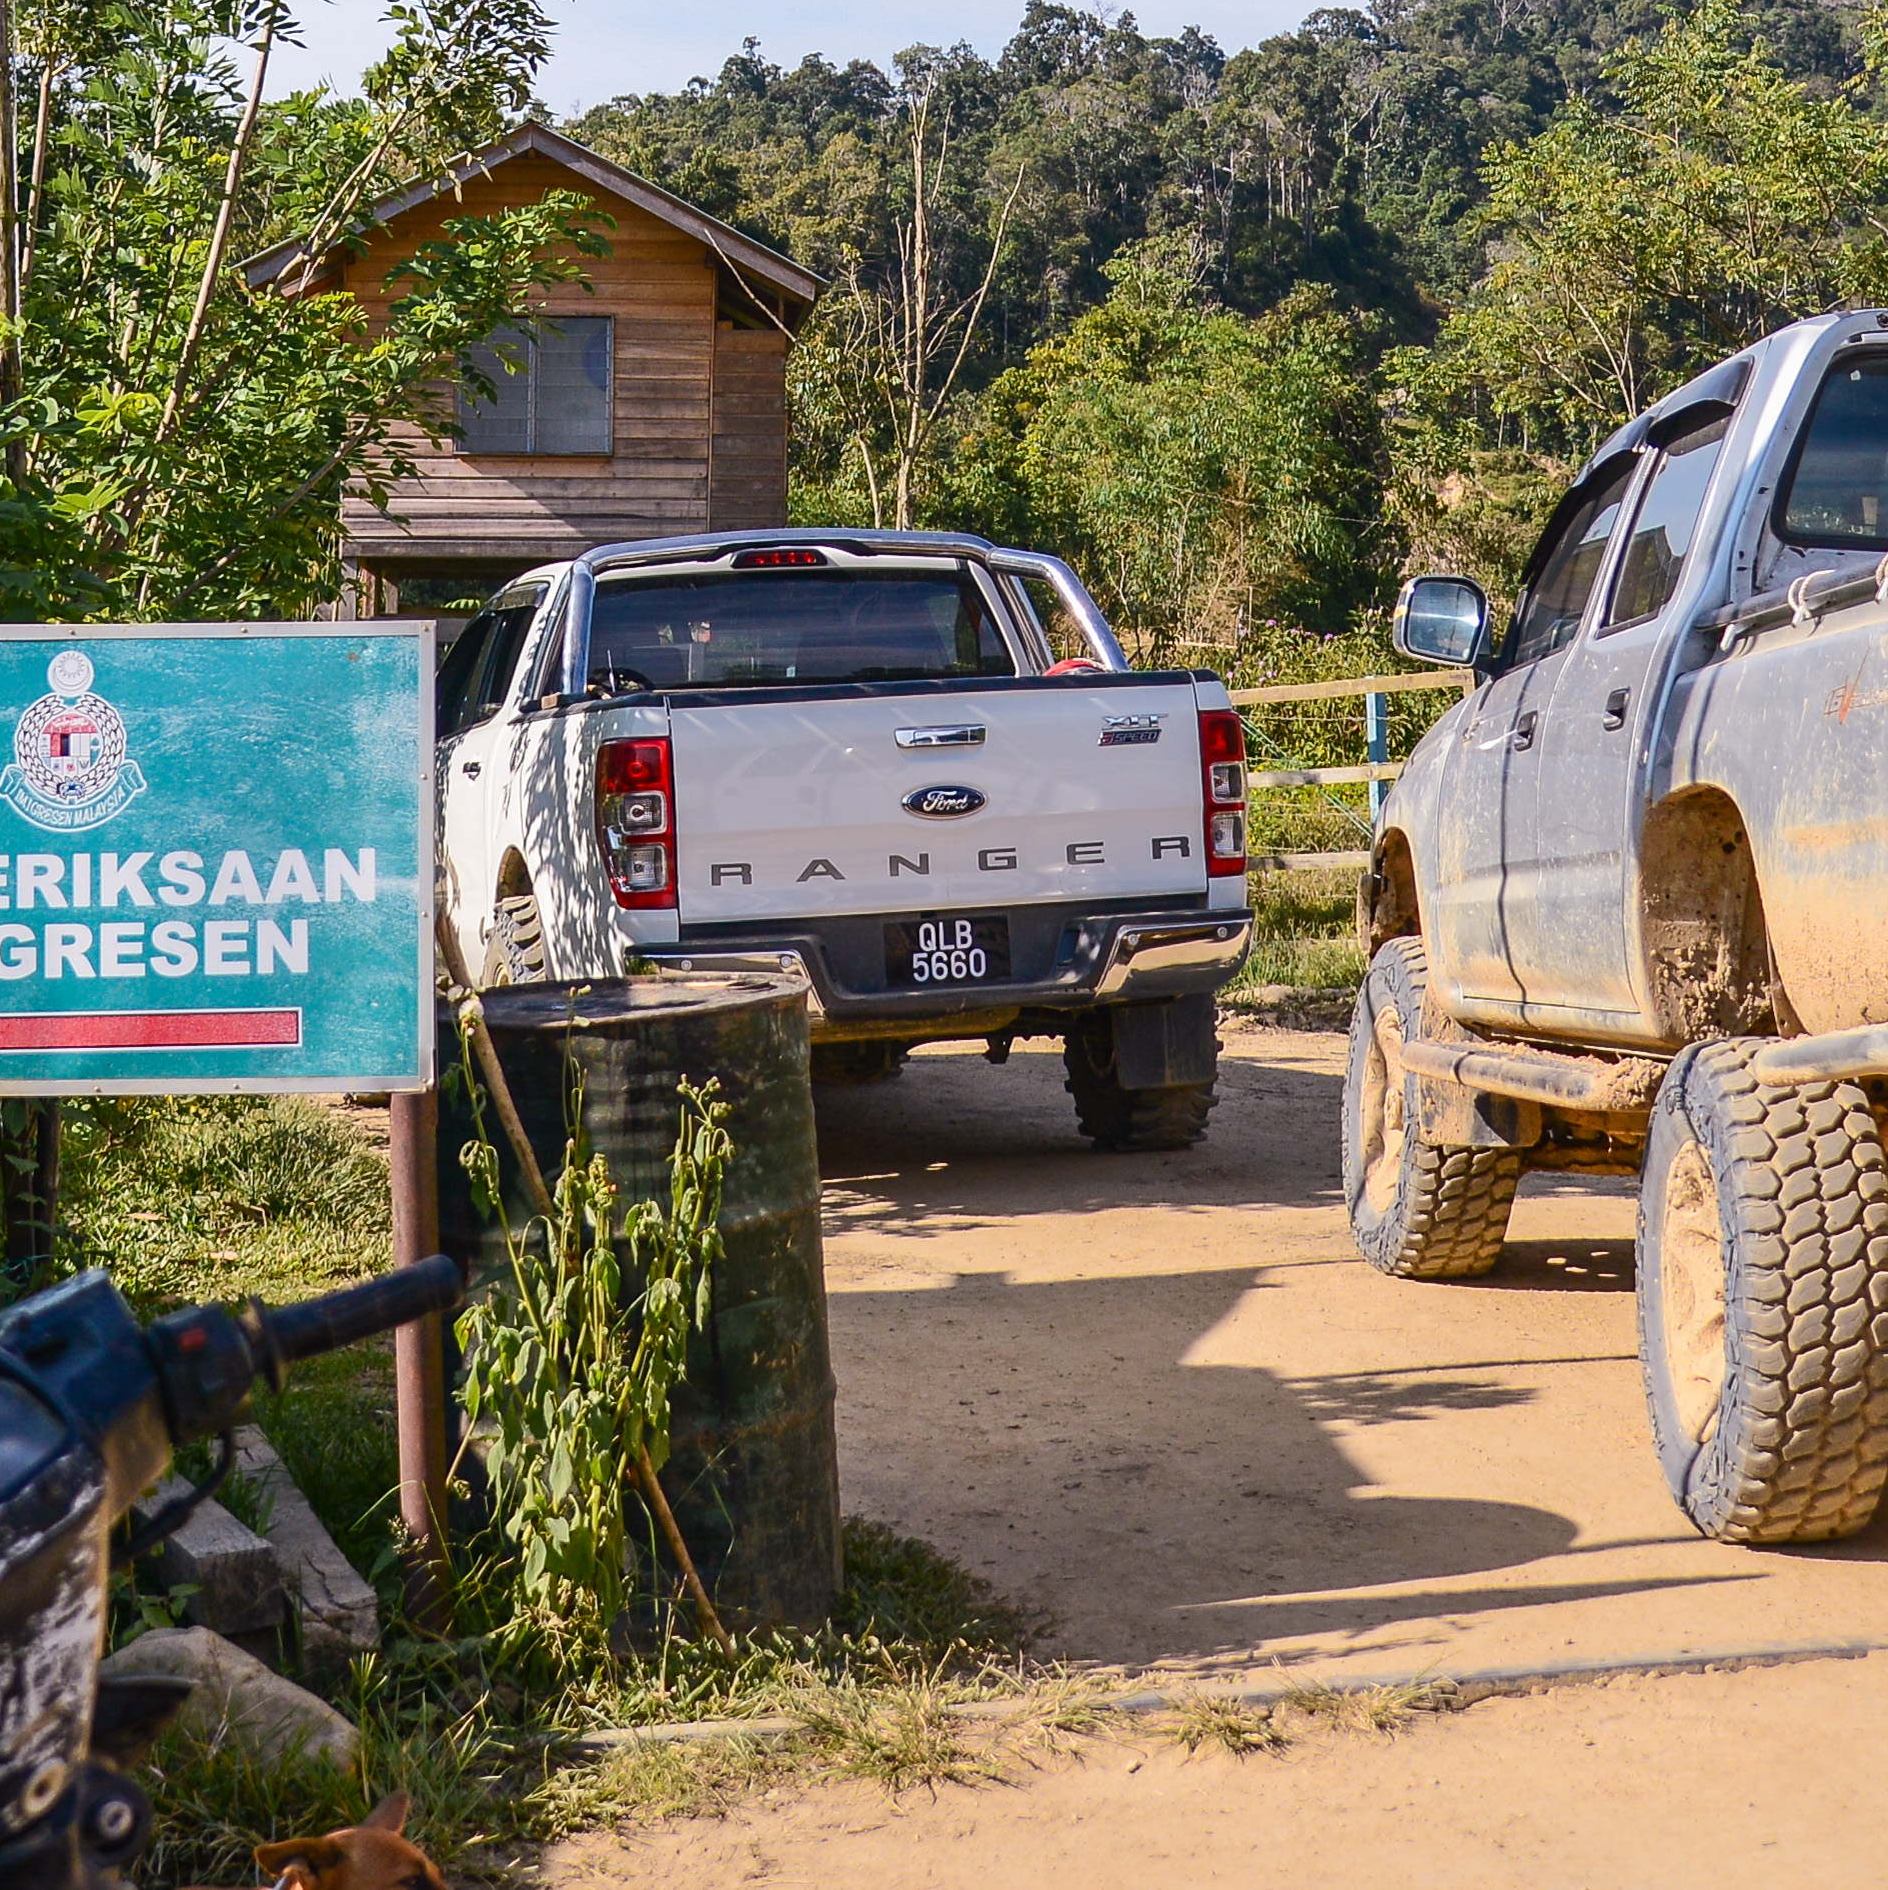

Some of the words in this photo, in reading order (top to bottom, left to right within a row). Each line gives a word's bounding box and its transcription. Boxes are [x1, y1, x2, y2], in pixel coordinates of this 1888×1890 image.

[1101, 713, 1169, 730] XLT
[14, 788, 73, 826] IMIGRESEN
[74, 785, 126, 826] MALAYSIA
[922, 790, 969, 812] Ford
[711, 835, 1191, 886] RANGER
[919, 919, 973, 951] QLB
[912, 948, 987, 982] 5660
